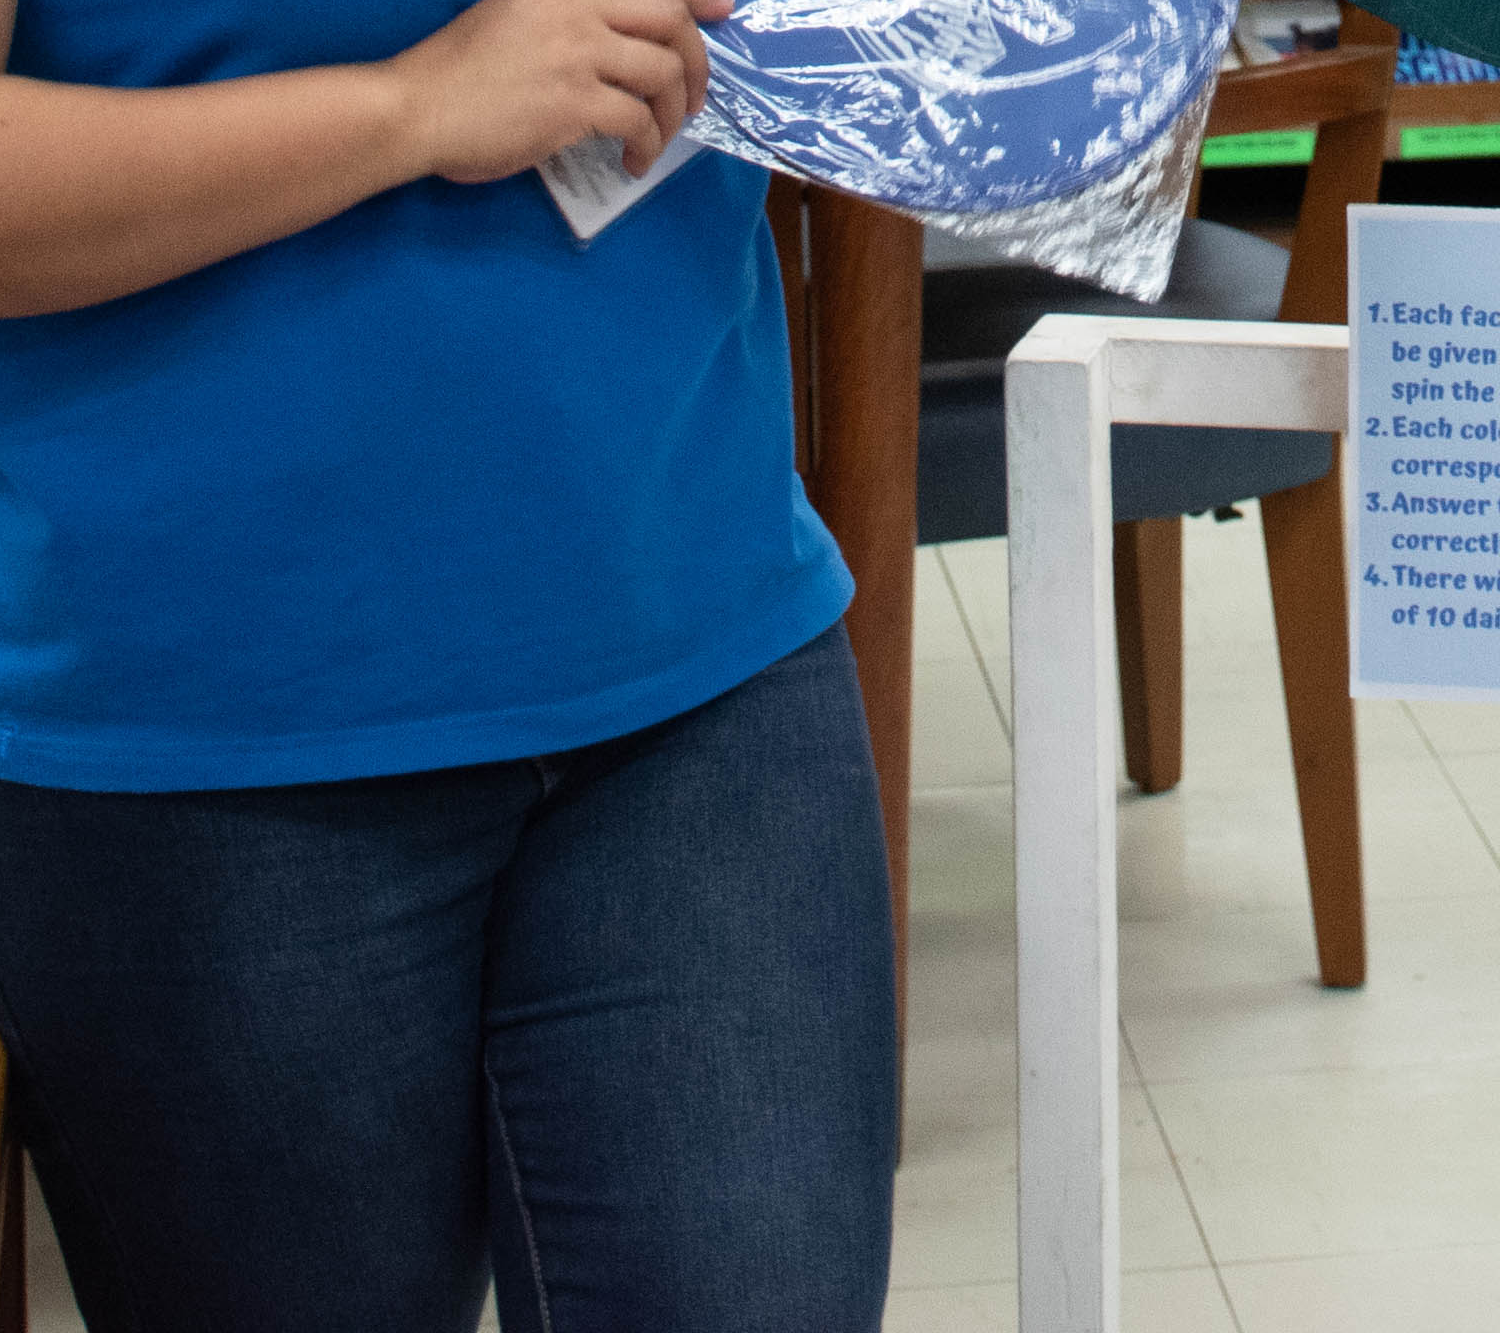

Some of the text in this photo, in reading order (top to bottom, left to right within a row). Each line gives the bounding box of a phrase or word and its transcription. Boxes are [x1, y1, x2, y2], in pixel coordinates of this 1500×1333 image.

[1368, 302, 1389, 323] 1.
[1392, 302, 1453, 325] Each
[1392, 341, 1422, 362] be
[1428, 341, 1497, 369] given
[1391, 378, 1445, 405] spin
[1451, 381, 1495, 402] the
[1365, 417, 1389, 437] 2.
[1392, 416, 1453, 439] Each
[1365, 492, 1389, 512] 3.
[1392, 491, 1491, 515] Answer
[1364, 564, 1389, 587] 4.
[1392, 564, 1467, 590] There
[1391, 604, 1420, 625] of
[1426, 606, 1456, 627] 10
